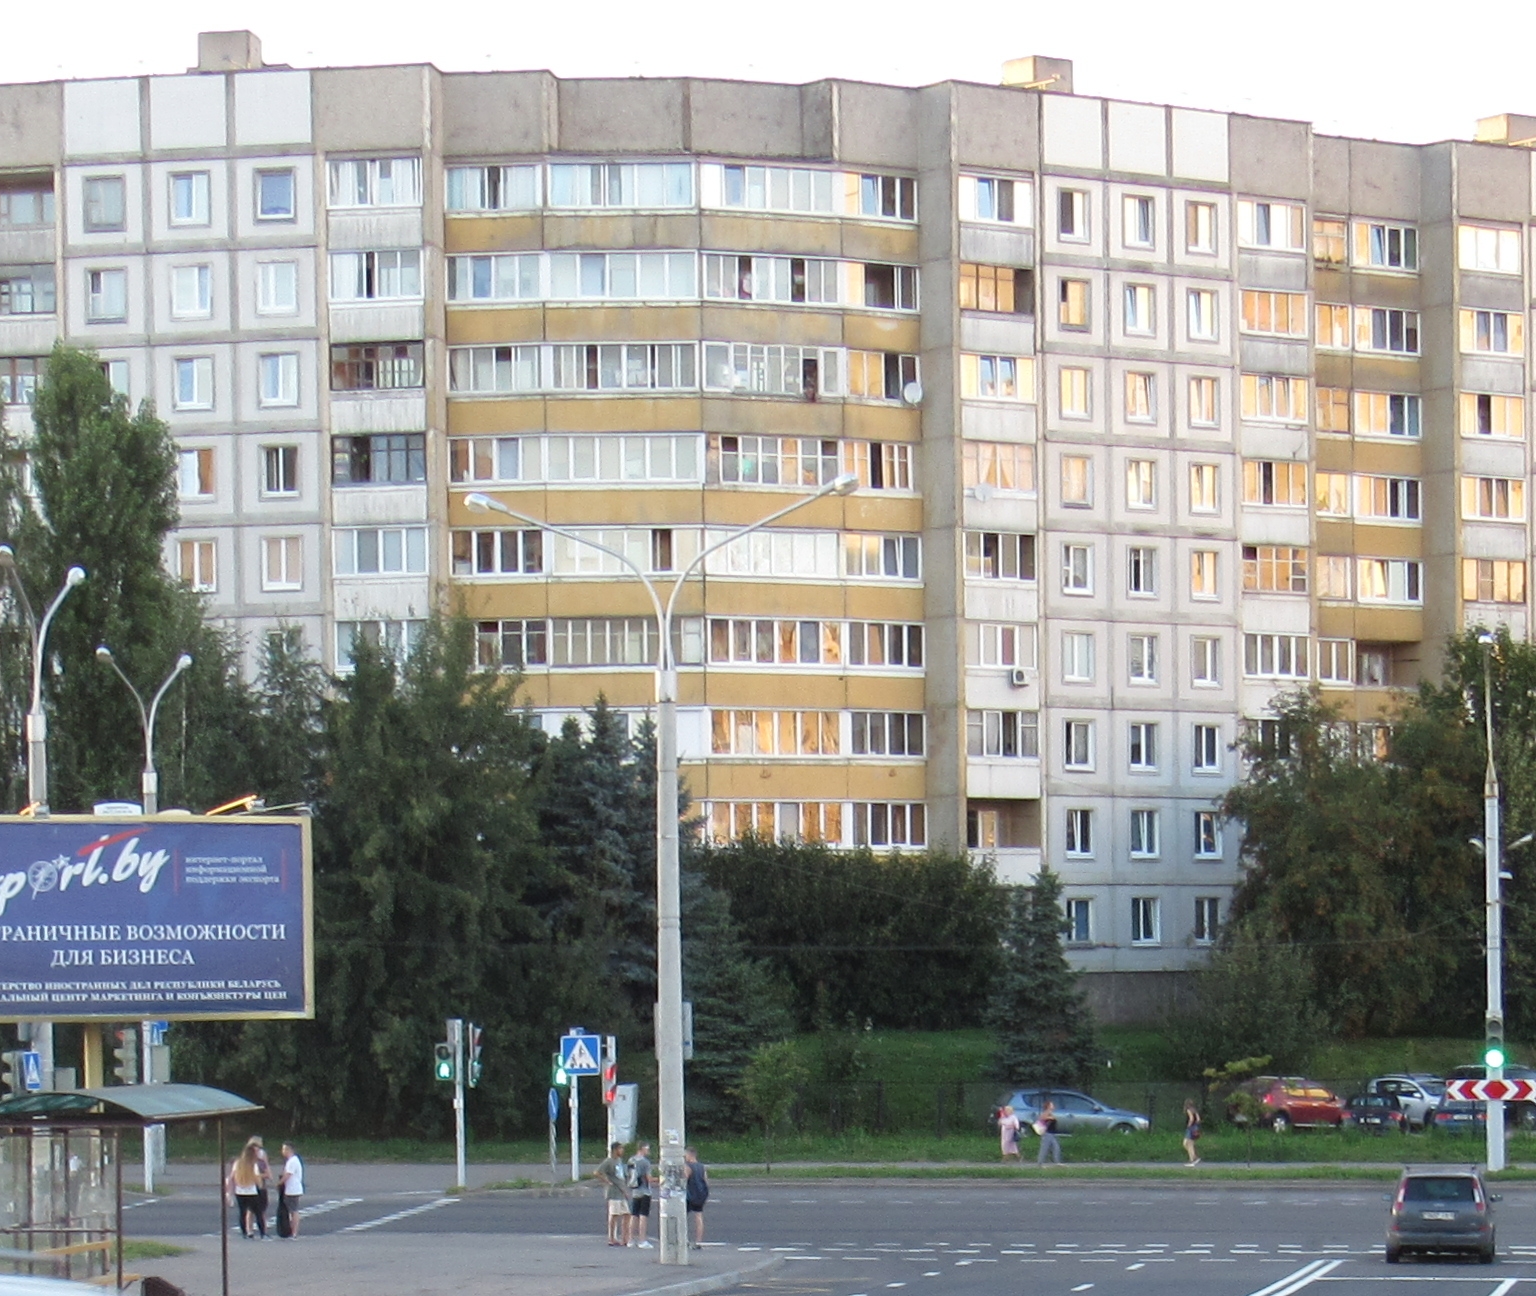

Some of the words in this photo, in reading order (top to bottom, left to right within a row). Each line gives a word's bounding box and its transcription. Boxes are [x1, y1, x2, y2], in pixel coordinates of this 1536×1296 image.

[127, 924, 286, 940] ВОЗМОЖНОСТИ
[50, 949, 94, 968] ДЛЯ
[100, 949, 195, 966] БИЗНЕСА
[44, 981, 127, 990] ИНОСТРАННЫХ
[154, 981, 225, 990] РЕСПУБЛИКИ
[228, 980, 281, 989] БЕЛАРУСЬ
[51, 993, 88, 1003] ЦЕНТР
[90, 993, 163, 1002] МАРКЕТИНГА
